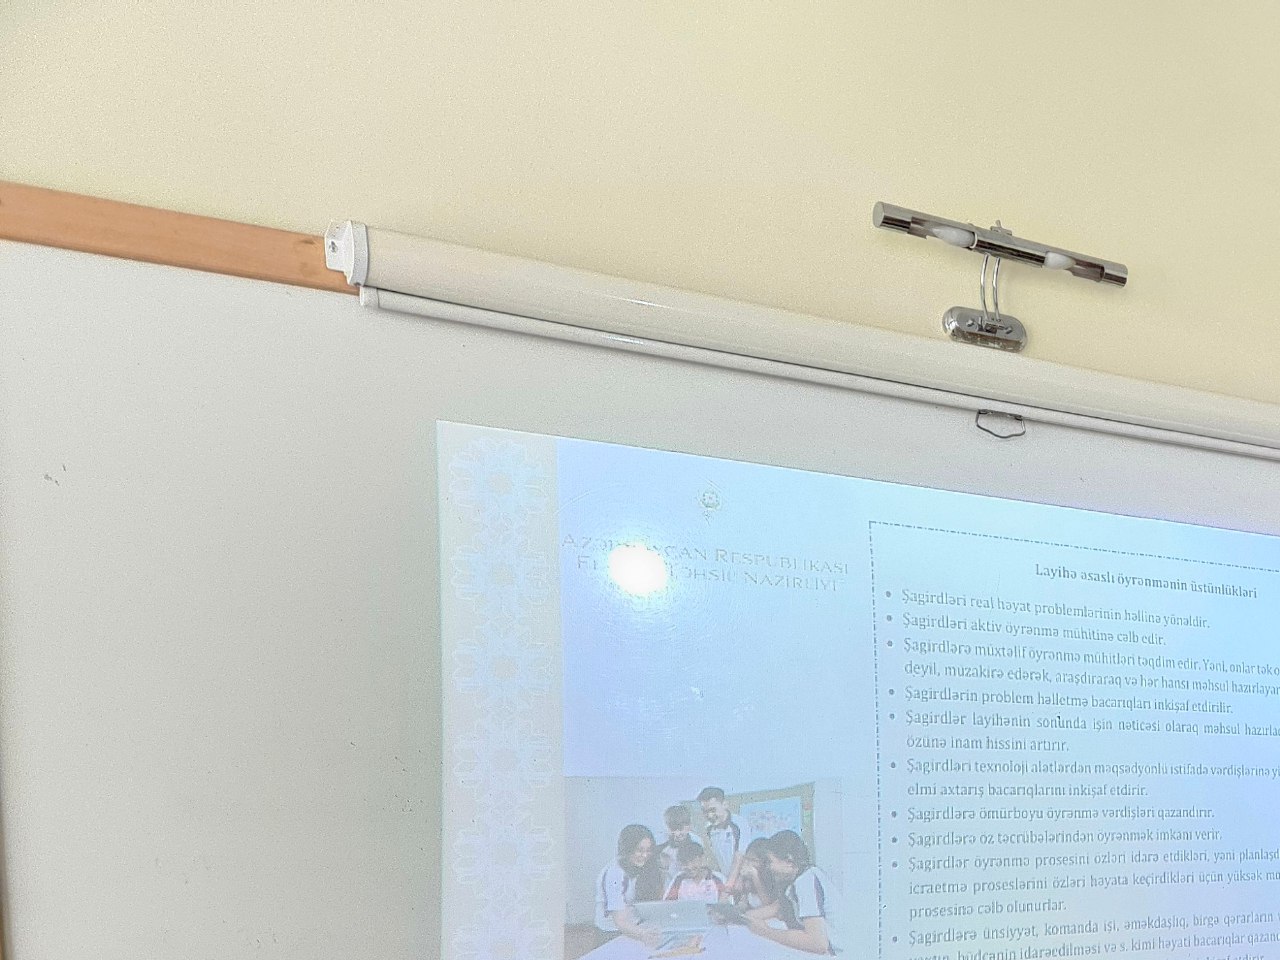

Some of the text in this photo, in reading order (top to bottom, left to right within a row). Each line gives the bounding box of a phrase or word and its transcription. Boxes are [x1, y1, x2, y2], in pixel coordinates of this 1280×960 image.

[1034, 563, 1257, 598] Layihə əsaslı öyrənmənin üstünlükləri
[901, 588, 1210, 630] Şagirdləri real həyat problemlərinin həllinə yönəldir.
[902, 612, 1166, 645] Şagirdləri aktiv öyrənmə mühitinə cəlb edir.
[904, 685, 1233, 713] Şagirdlərin problem həlletmə bacarıqları inkişaf etdirilir.
